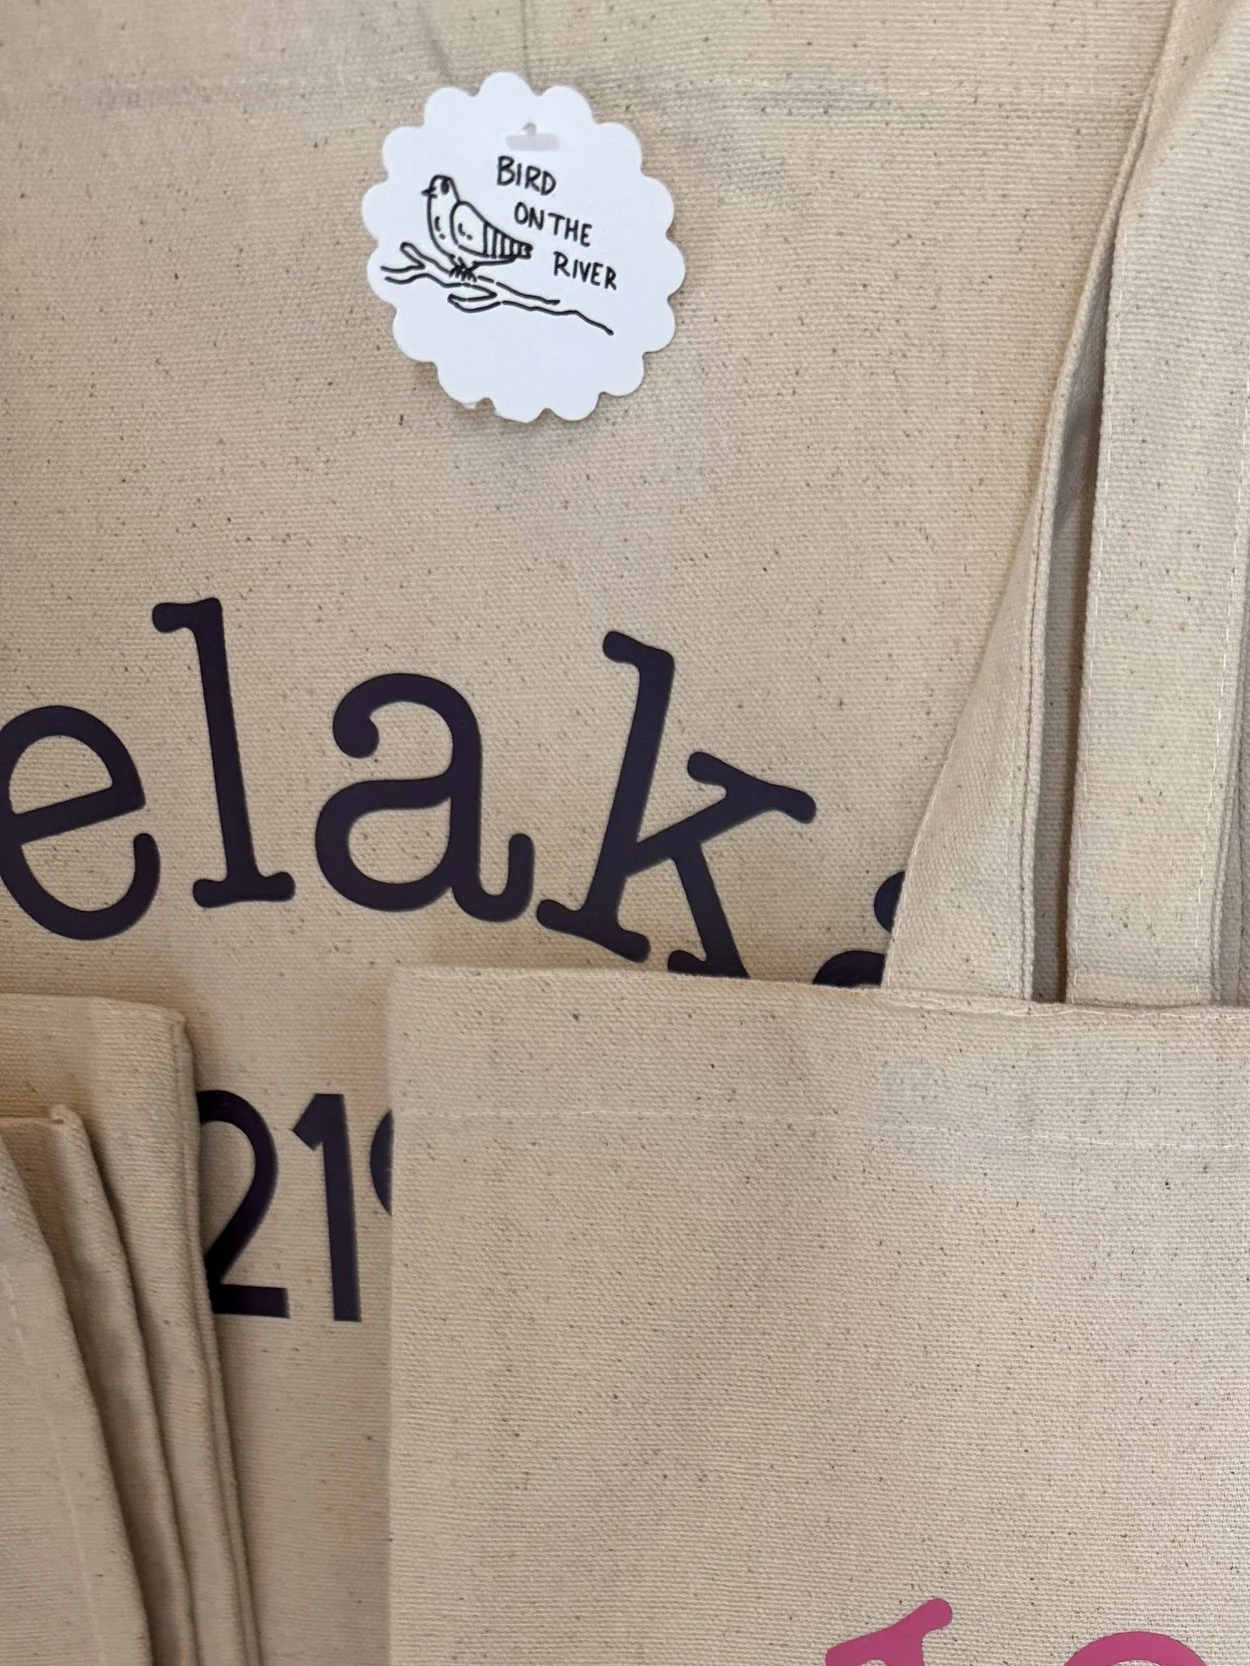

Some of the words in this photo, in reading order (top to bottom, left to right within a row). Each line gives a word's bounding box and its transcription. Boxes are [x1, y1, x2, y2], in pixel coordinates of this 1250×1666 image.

[496, 155, 556, 196] BIRD
[513, 201, 546, 231] ON
[547, 212, 593, 247] THE
[554, 251, 617, 291] RIVER
